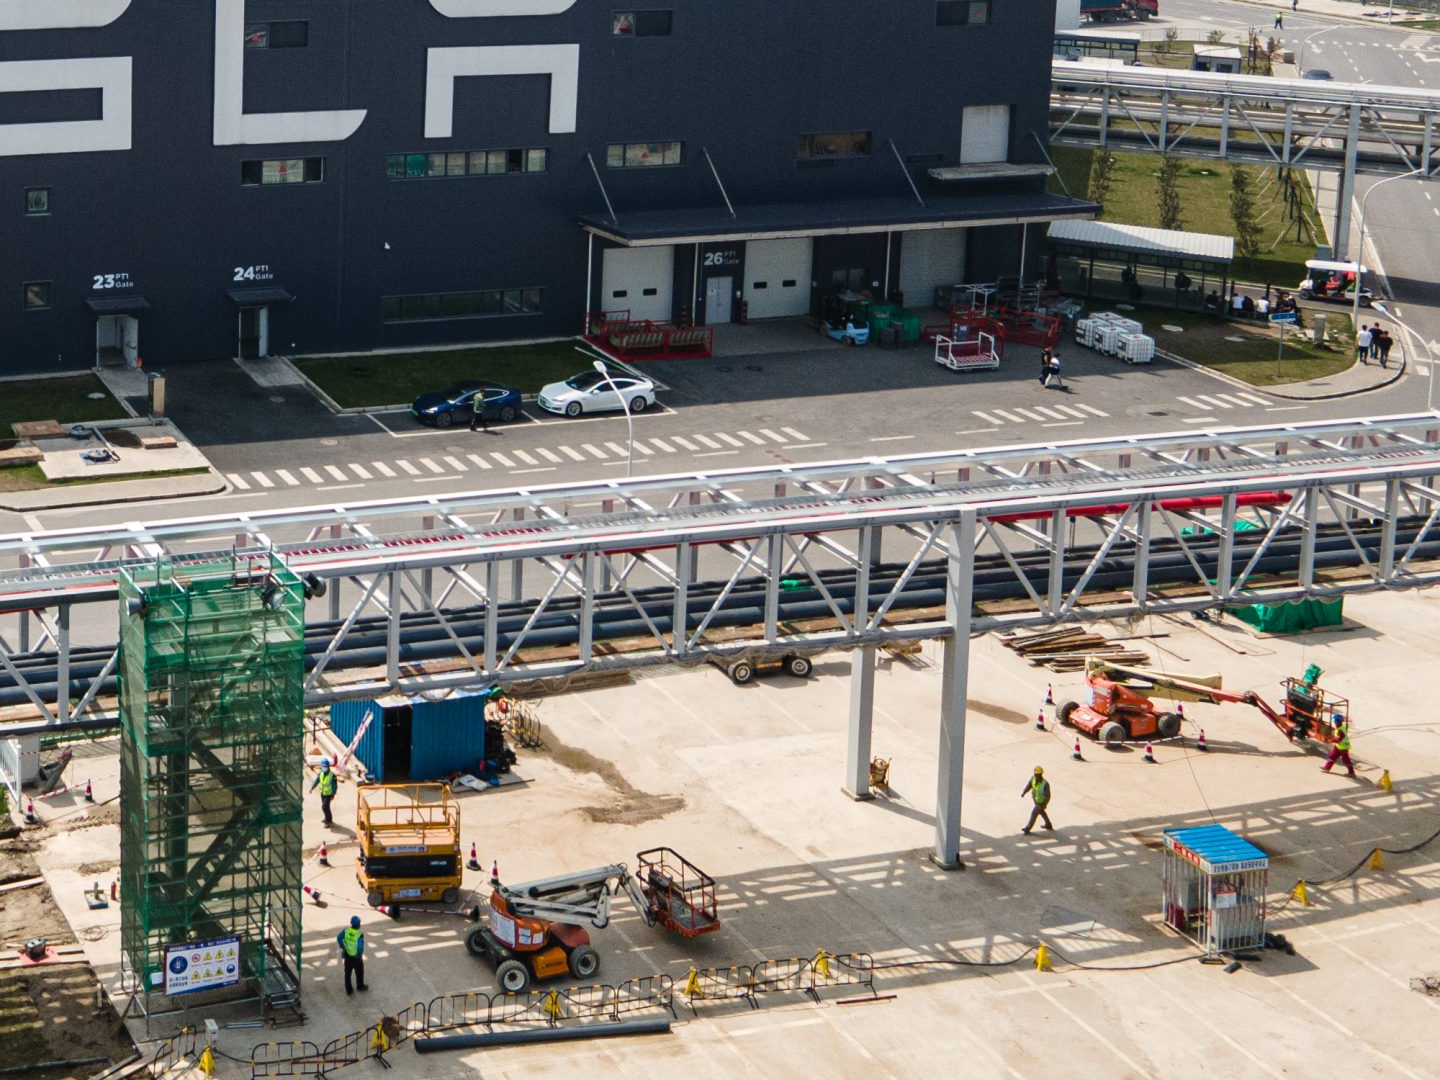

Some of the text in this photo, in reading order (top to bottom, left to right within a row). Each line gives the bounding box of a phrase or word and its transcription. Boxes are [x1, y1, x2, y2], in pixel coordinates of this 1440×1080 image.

[703, 251, 724, 266] 26
[233, 265, 255, 281] 24
[255, 264, 269, 272] PT1
[92, 273, 115, 290] 23
[115, 272, 129, 280] PT1
[115, 280, 134, 288] Gate
